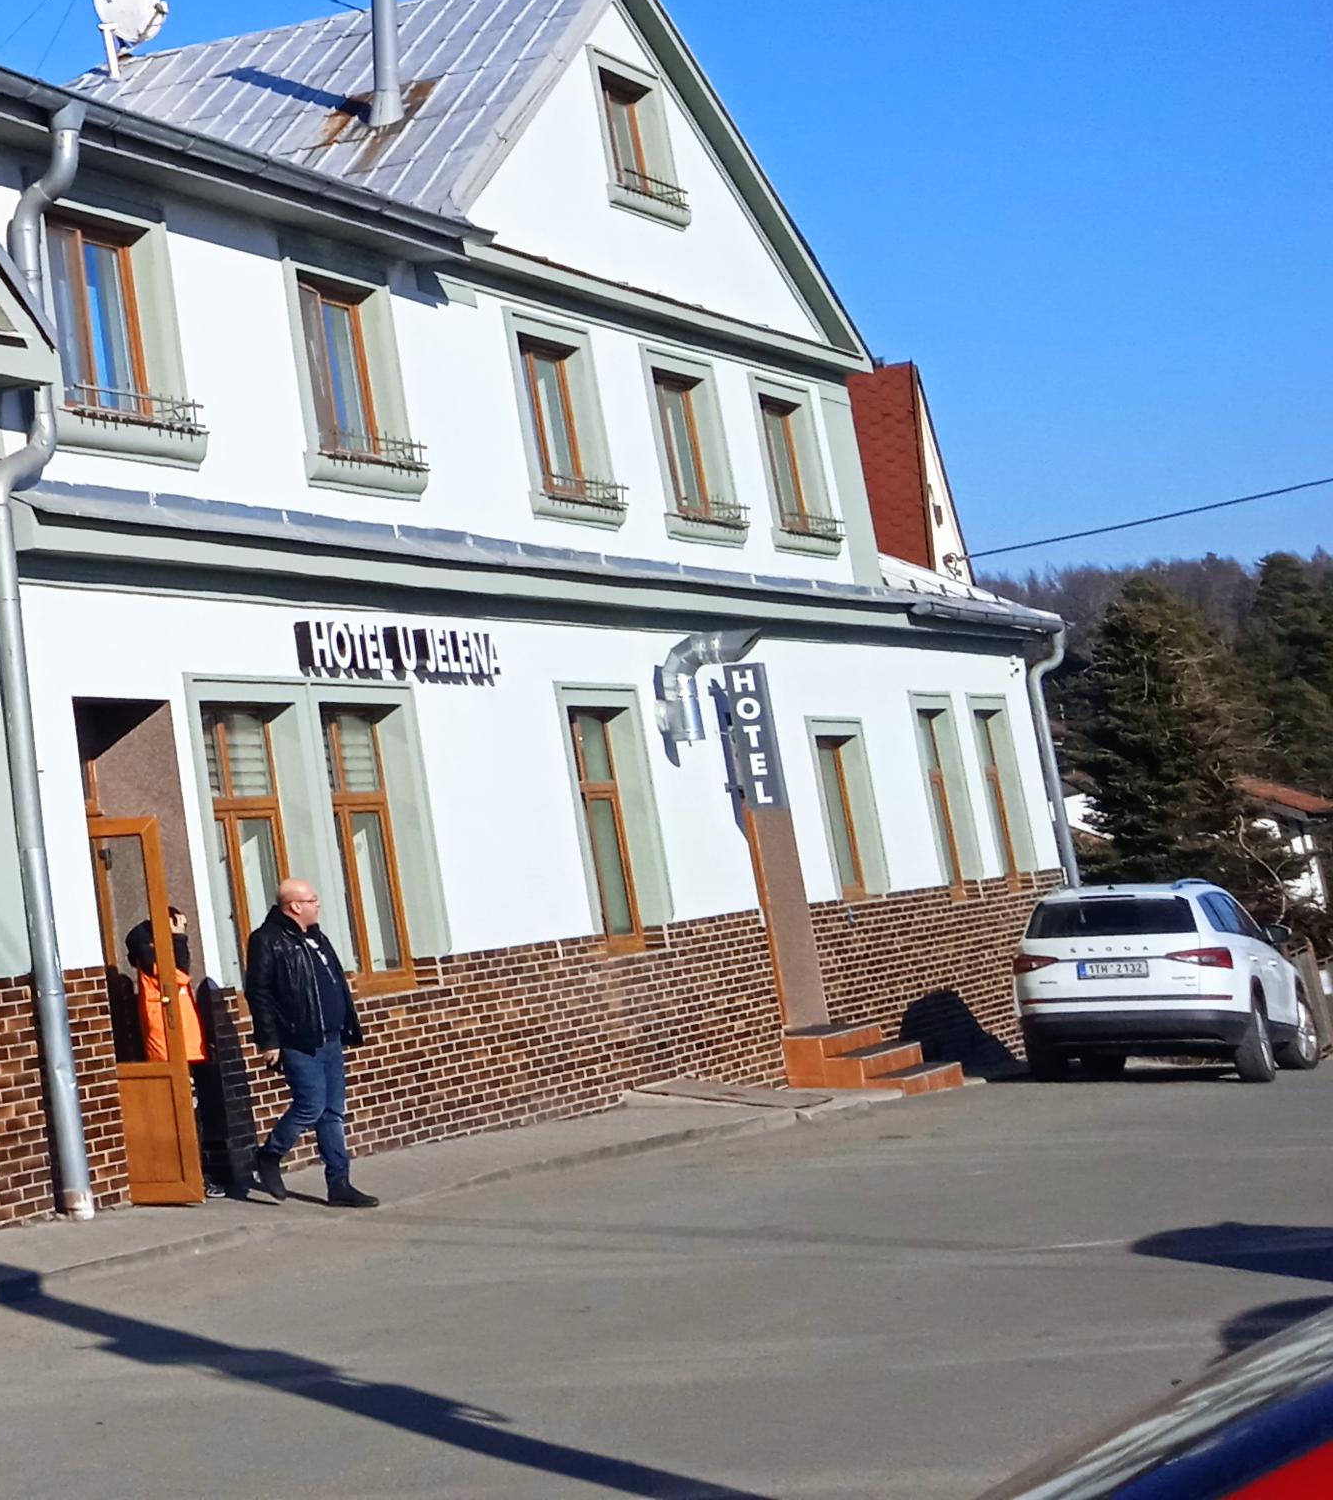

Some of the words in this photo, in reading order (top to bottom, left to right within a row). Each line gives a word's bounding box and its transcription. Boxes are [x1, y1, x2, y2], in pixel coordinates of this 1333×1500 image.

[309, 621, 393, 670] HOTEL
[395, 626, 418, 671] U
[424, 628, 502, 675] JELENA
[731, 669, 773, 804] HOTEL
[1116, 963, 1144, 974] 2132
